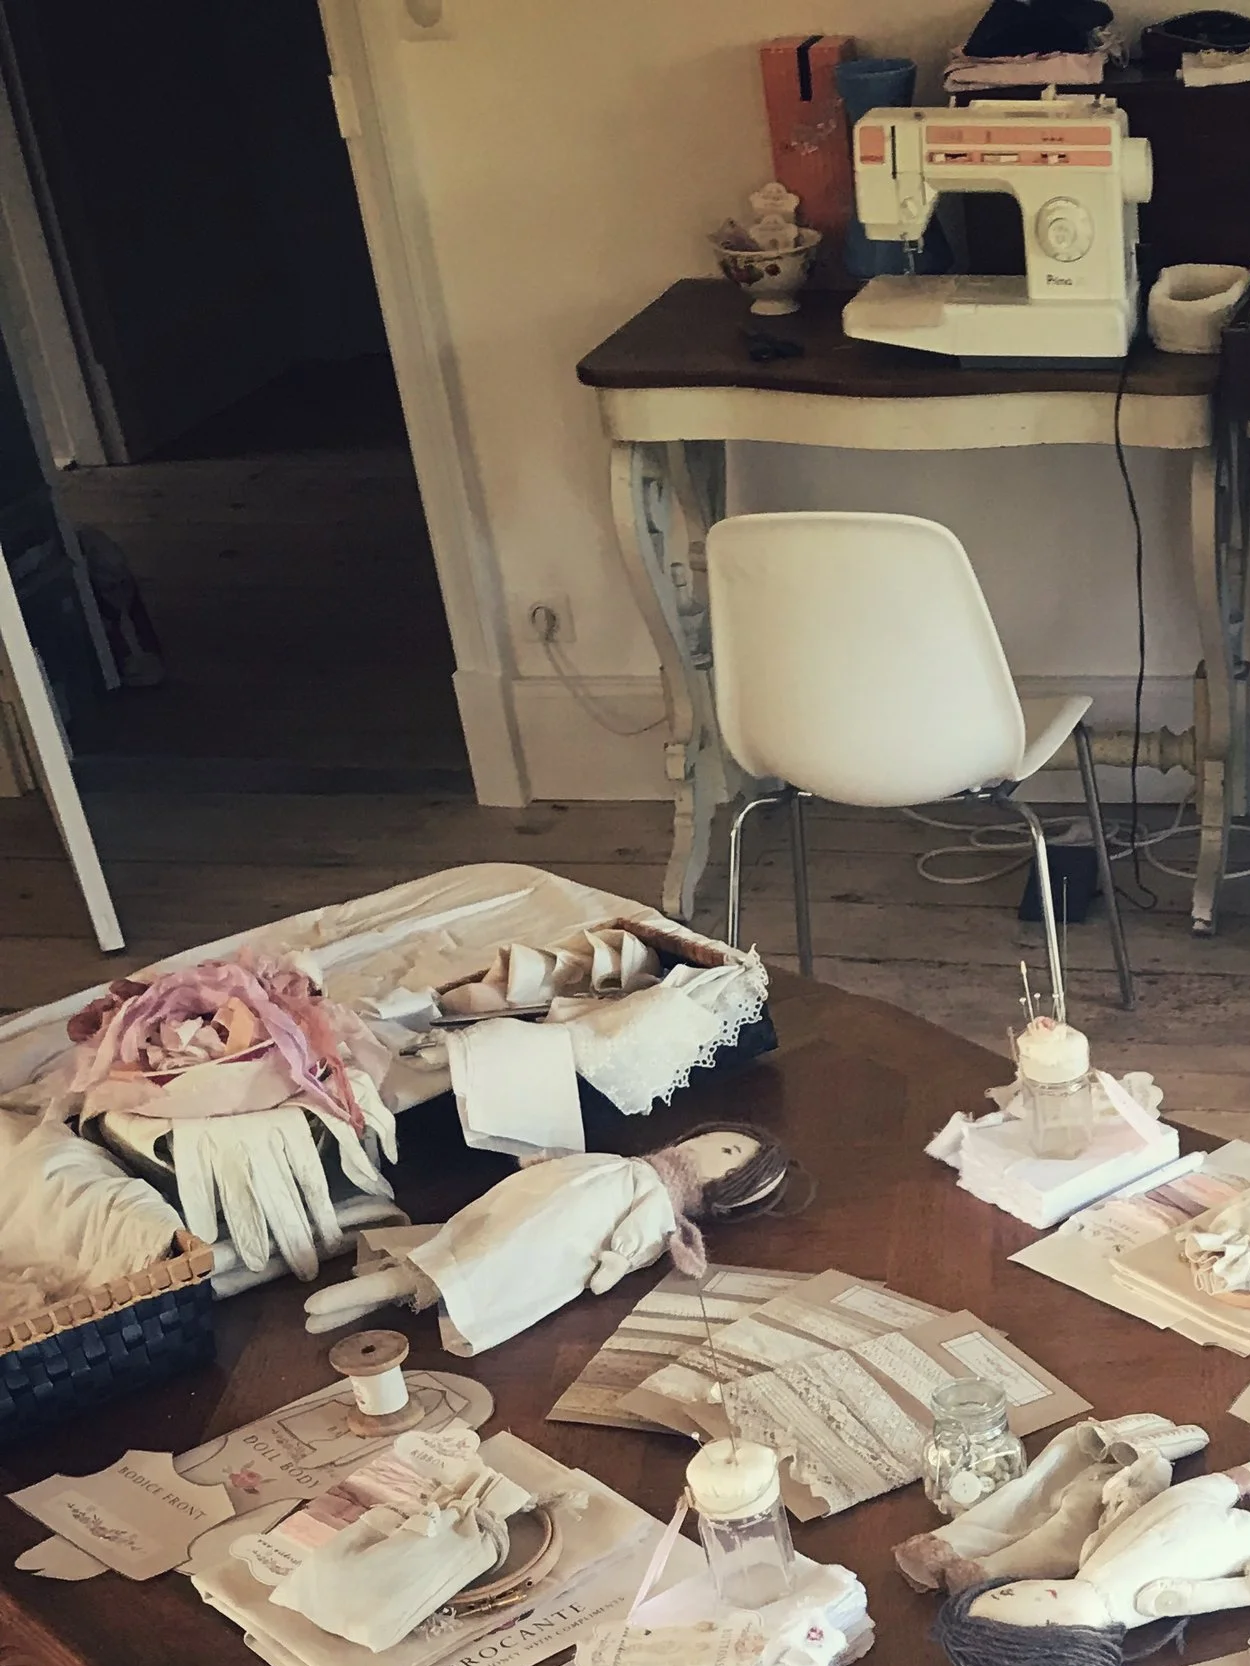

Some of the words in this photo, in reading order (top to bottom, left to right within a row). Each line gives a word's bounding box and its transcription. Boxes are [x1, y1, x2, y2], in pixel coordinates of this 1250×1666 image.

[242, 1434, 281, 1463] DOLL
[279, 1461, 320, 1489] BODY
[117, 1465, 164, 1495] BODICE
[162, 1492, 207, 1521] FRONT
[523, 1634, 553, 1651] WITH
